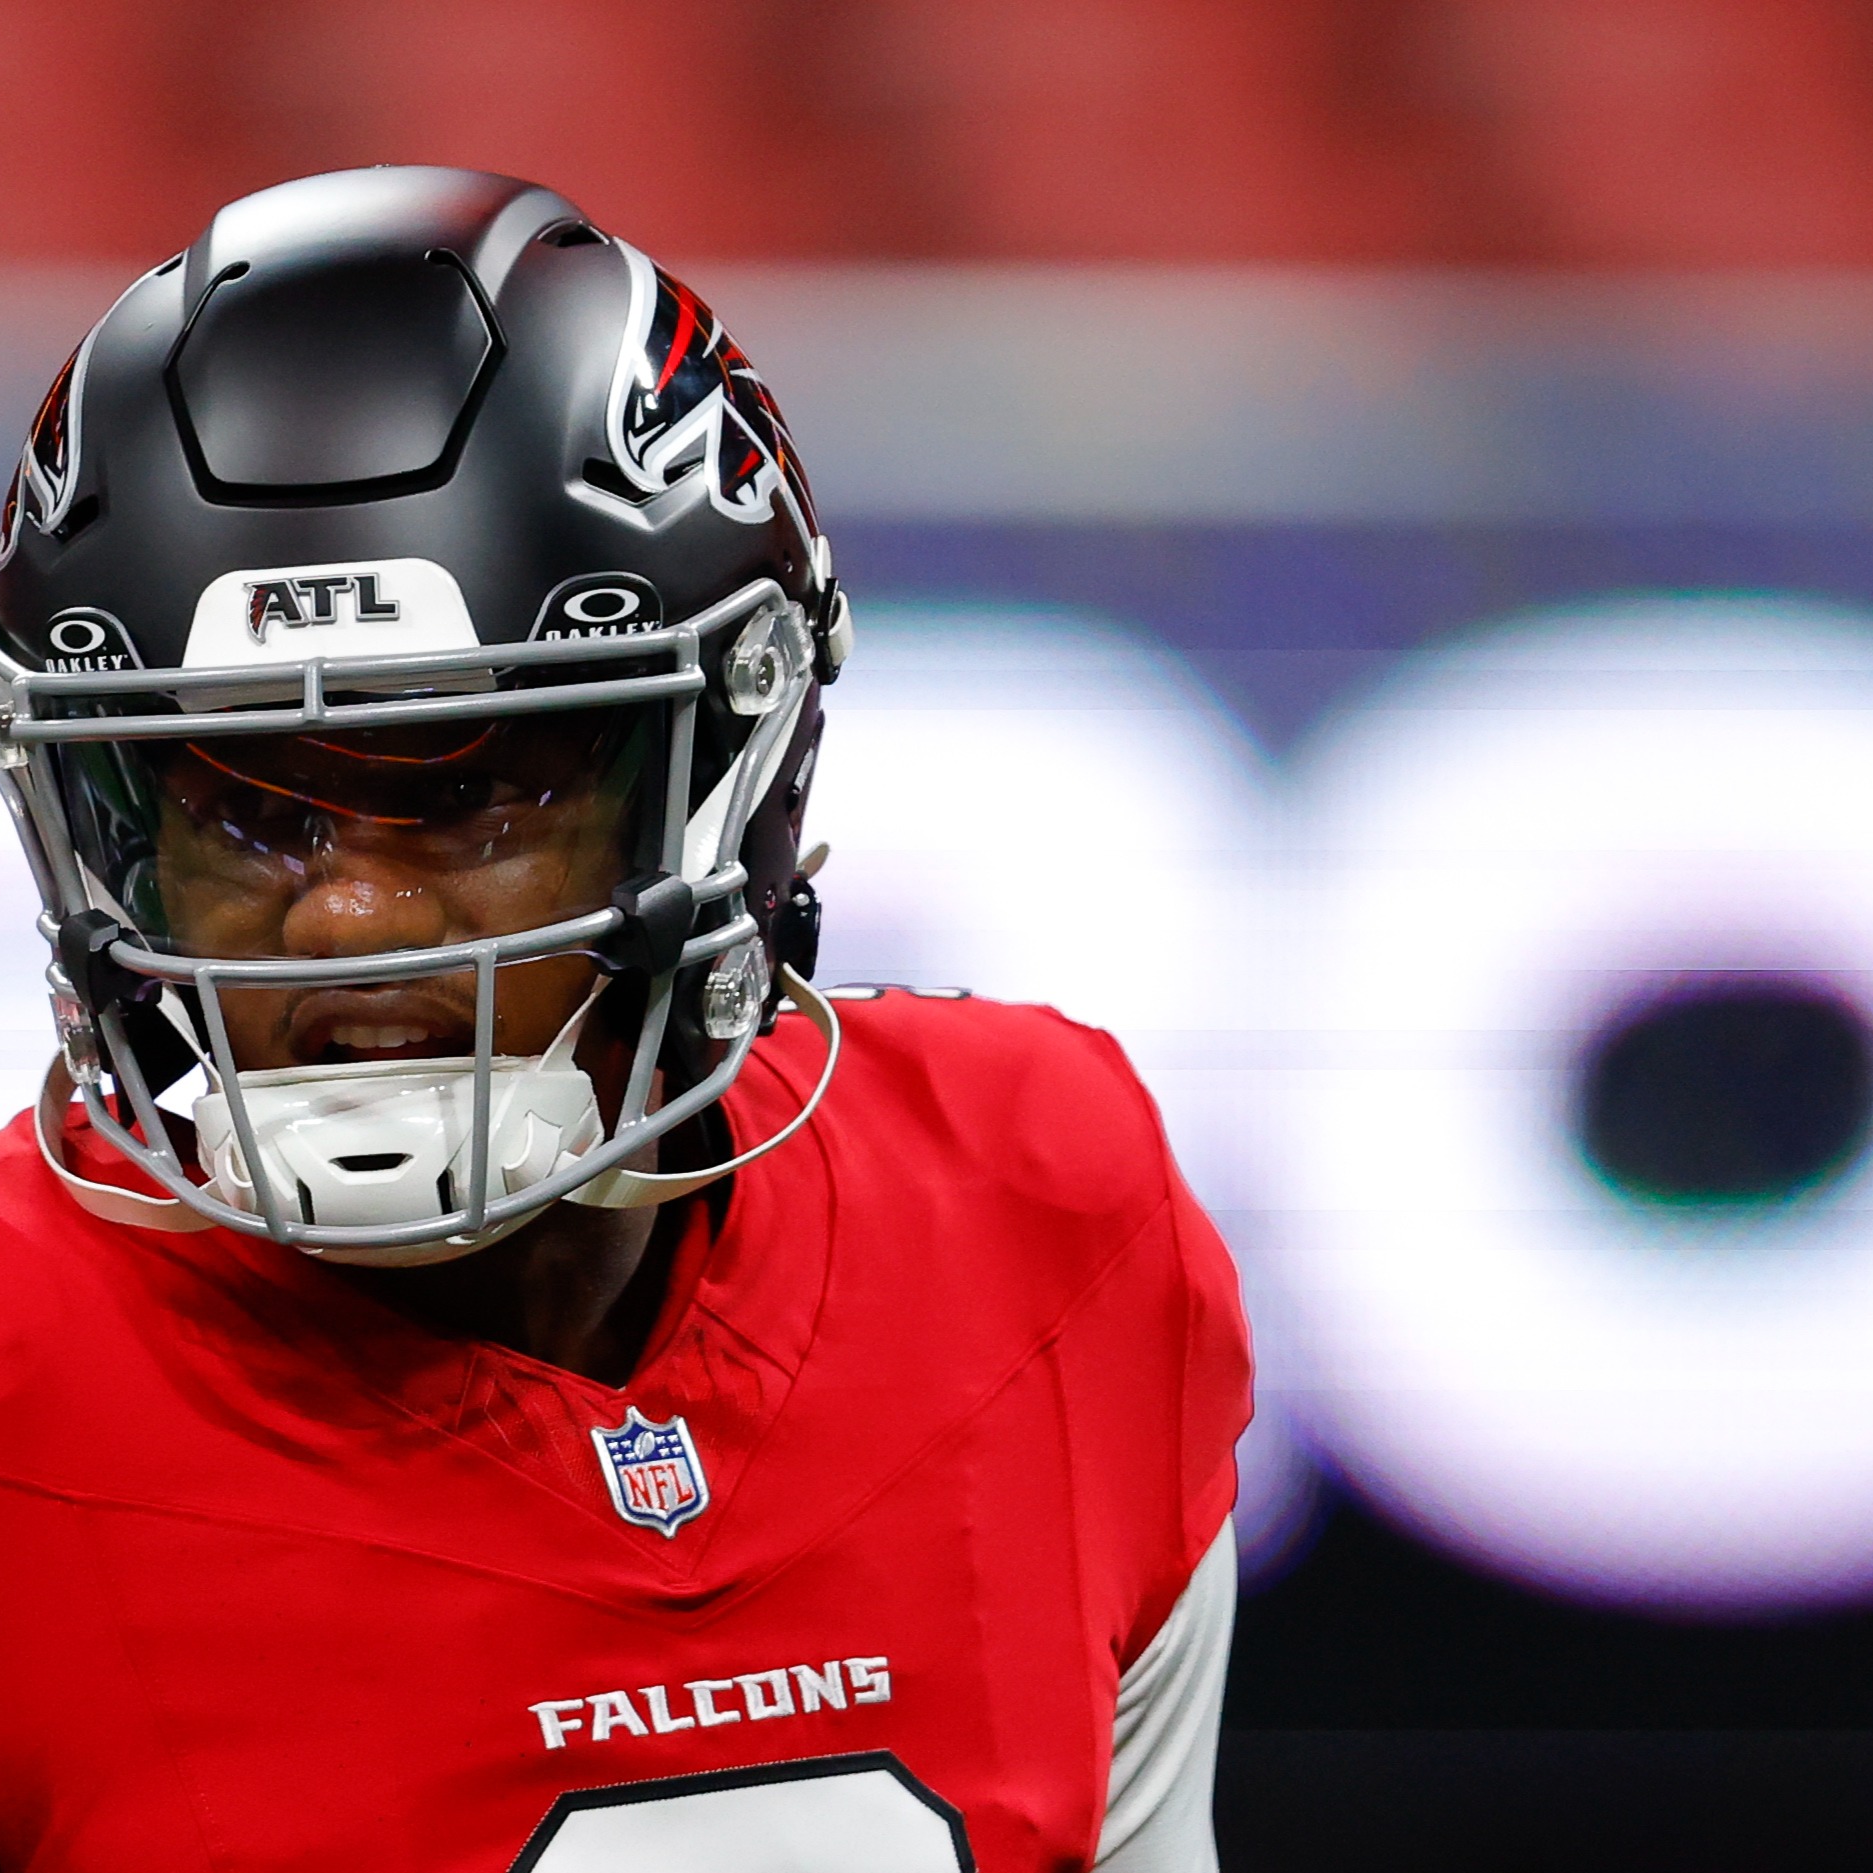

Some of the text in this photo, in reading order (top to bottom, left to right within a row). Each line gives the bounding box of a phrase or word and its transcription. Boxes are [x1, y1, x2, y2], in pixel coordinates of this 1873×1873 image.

[243, 572, 400, 646] ATL
[45, 654, 125, 673] OAKLEY
[623, 1462, 694, 1512] NFL
[527, 1655, 892, 1750] FALCONS
